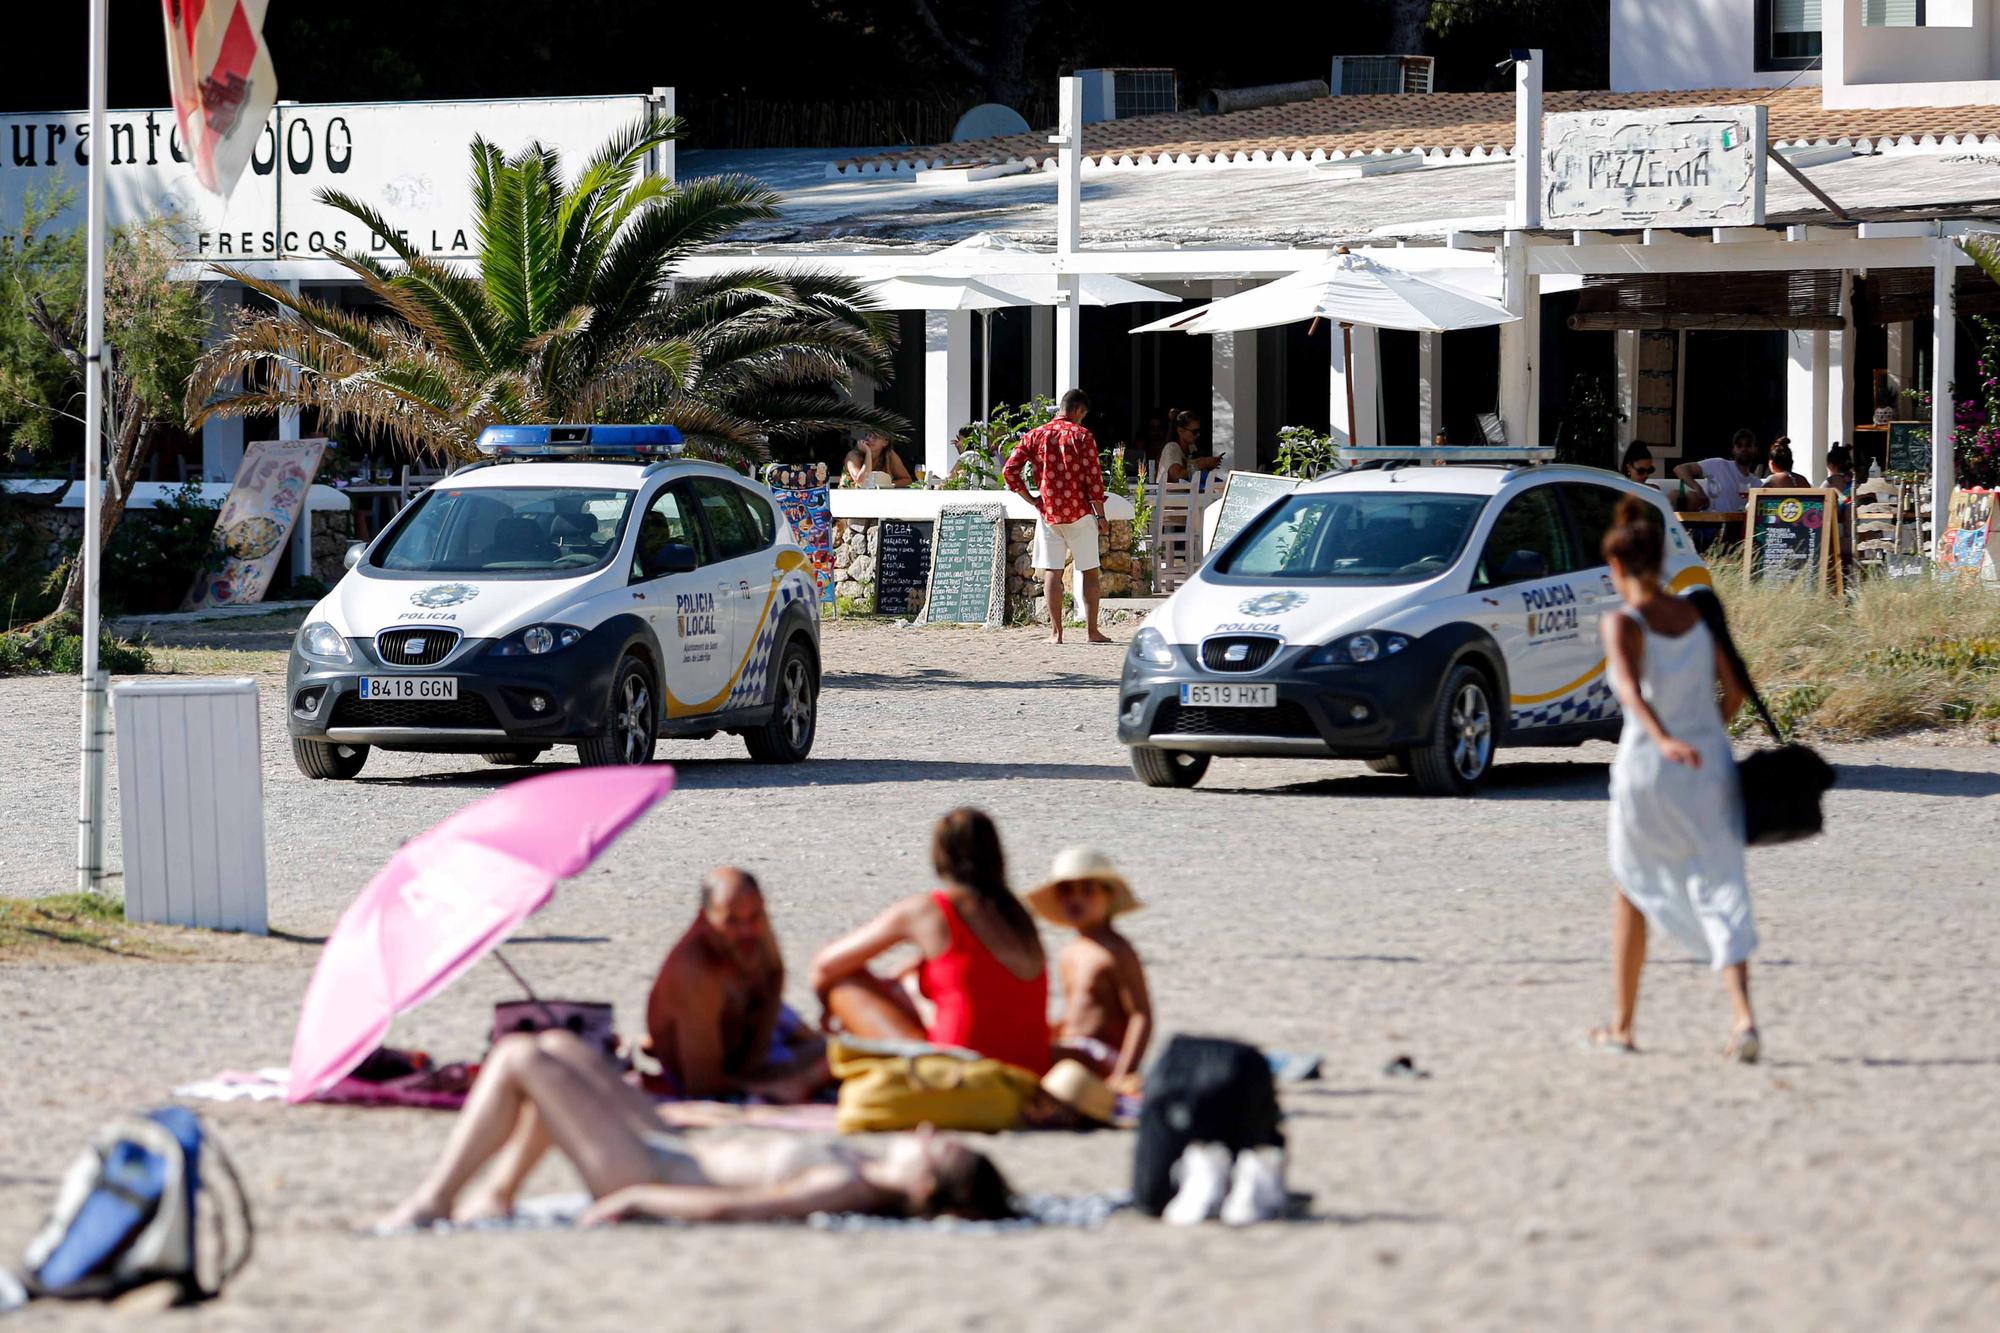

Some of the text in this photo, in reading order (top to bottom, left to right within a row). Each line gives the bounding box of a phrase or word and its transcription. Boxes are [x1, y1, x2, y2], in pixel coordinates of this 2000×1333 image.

[251, 116, 352, 176] 000
[199, 230, 348, 254] FRESCOS
[432, 229, 469, 251] LA
[676, 593, 715, 614] POLICIA
[1521, 583, 1577, 612] POLICIA
[397, 612, 457, 621] POLICIA
[686, 615, 716, 637] LOCAL
[1538, 607, 1579, 635] LOCAL
[1214, 622, 1282, 633] POLICIA
[371, 680, 412, 697] 8418
[420, 680, 453, 697] GGN
[1192, 686, 1232, 703] 6519
[1239, 687, 1270, 703] HXT
